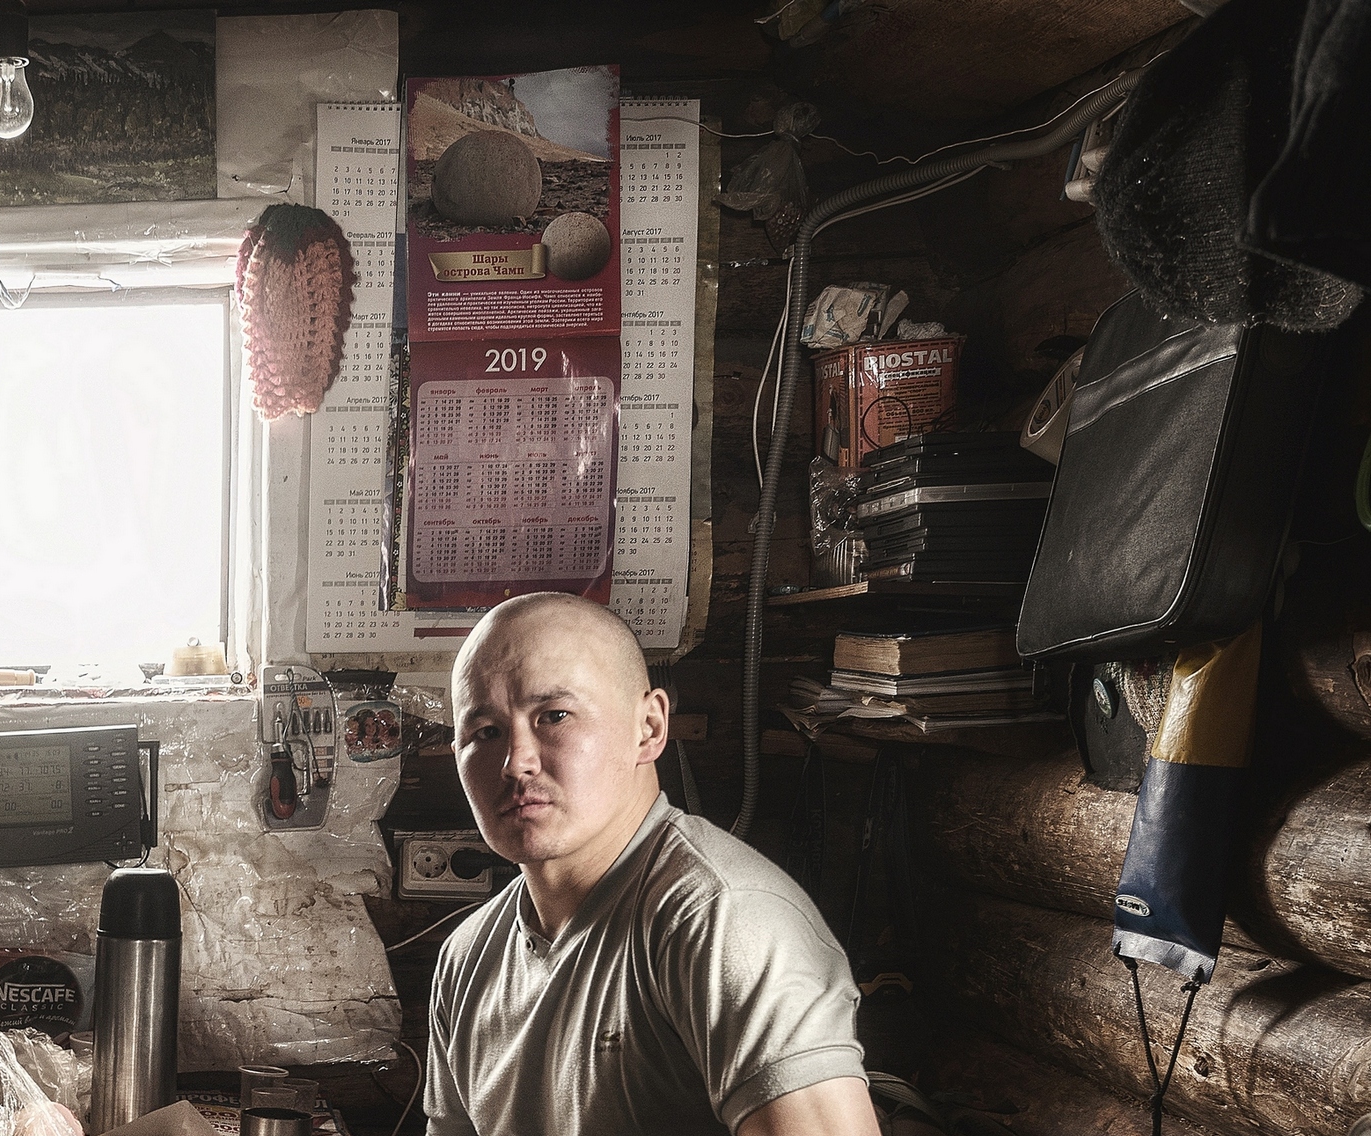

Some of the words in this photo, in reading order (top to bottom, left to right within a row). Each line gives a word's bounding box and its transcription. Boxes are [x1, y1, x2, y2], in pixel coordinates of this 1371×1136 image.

[351, 137, 375, 146] Январь
[375, 138, 391, 146] 2017
[626, 134, 645, 142] Июль
[645, 134, 662, 142] 2017
[346, 231, 376, 240] Февраль
[376, 231, 393, 239] 2017
[622, 228, 645, 237] Август
[645, 228, 662, 236] 2017
[472, 254, 509, 266] Шары
[443, 267, 491, 278] острова
[493, 266, 525, 276] Чамп
[351, 313, 369, 321] Март
[369, 312, 386, 320] 2017
[620, 311, 647, 319] ентябрь
[647, 310, 664, 318] 2017
[484, 347, 548, 373] 2019
[863, 348, 953, 371] BIOSTAL
[346, 396, 371, 405] Апрель
[371, 396, 388, 404] 2017
[349, 489, 364, 497] Май
[364, 489, 381, 497] 2017
[345, 571, 364, 579] Июнь
[269, 682, 308, 692] ОТВЕТКА
[0, 1002, 64, 1012] CLASSIC
